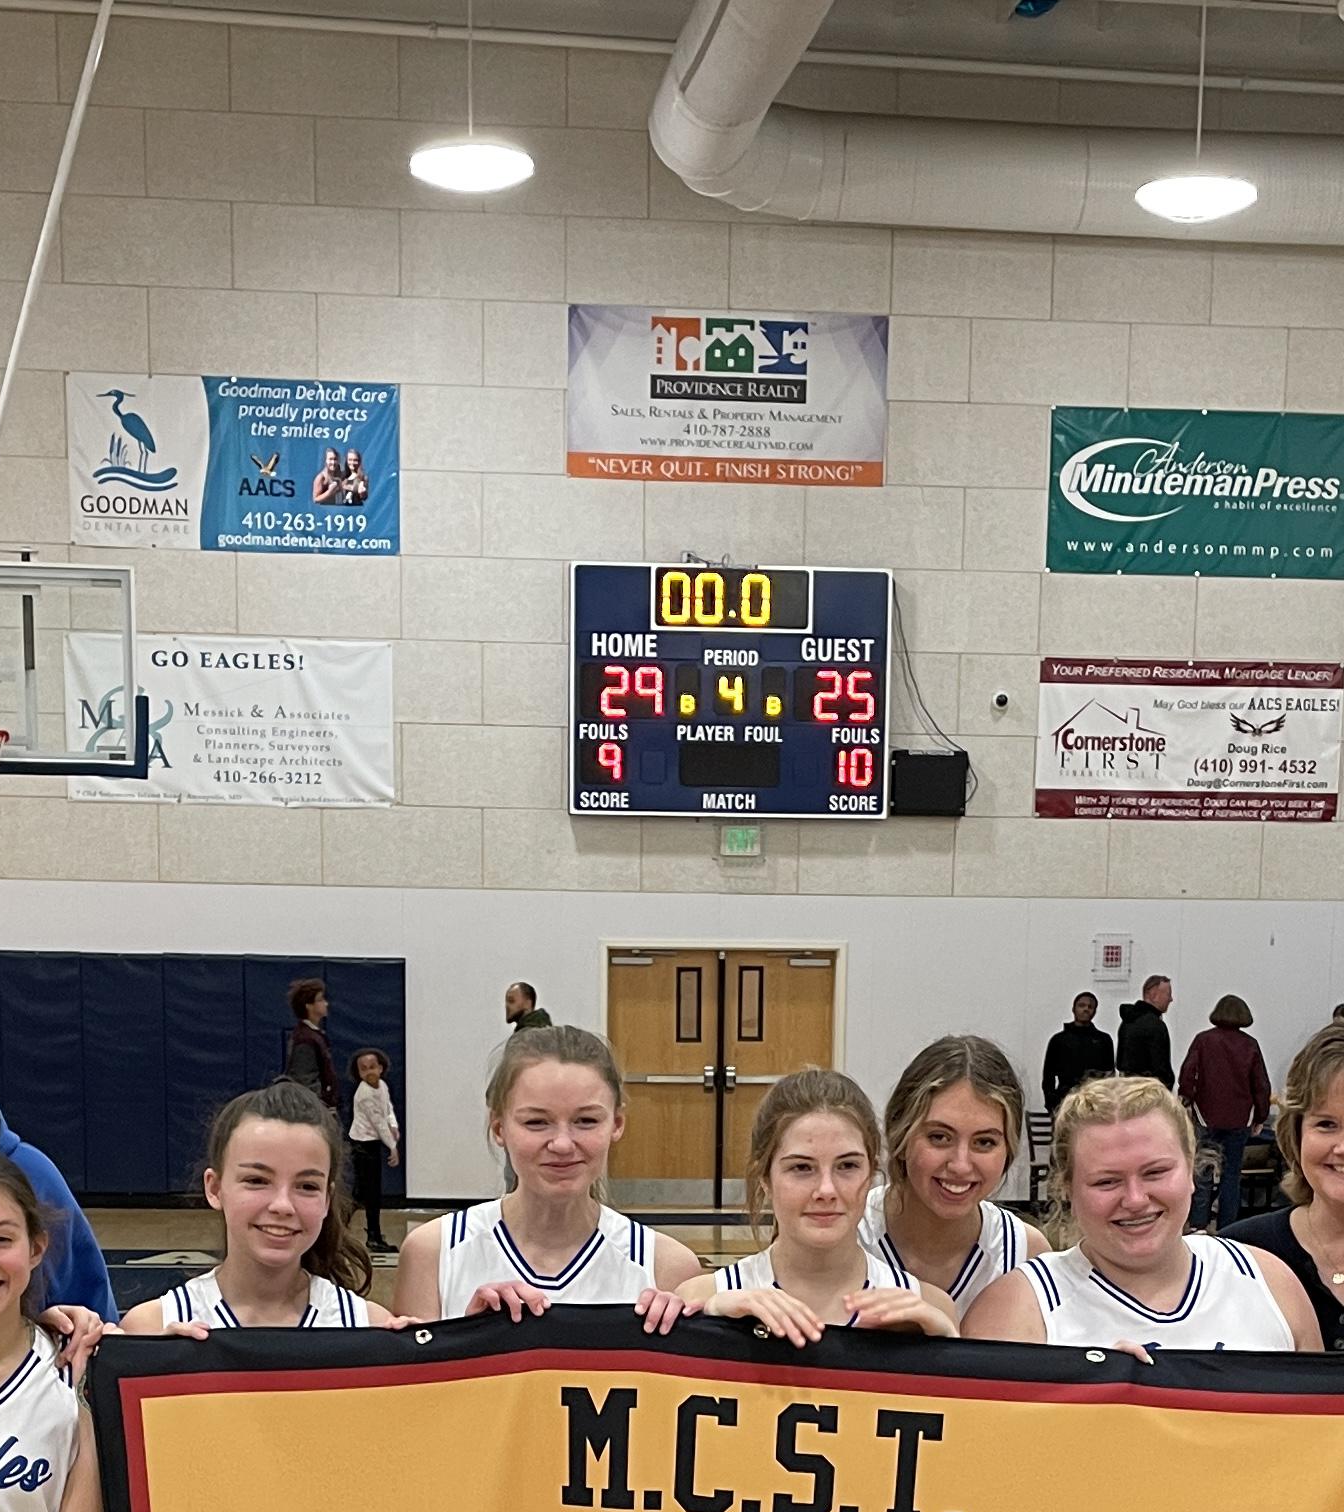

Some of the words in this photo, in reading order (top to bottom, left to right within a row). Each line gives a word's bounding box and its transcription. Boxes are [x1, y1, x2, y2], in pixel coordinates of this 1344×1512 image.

[219, 382, 290, 399] Goodman
[295, 383, 346, 402] Dental
[351, 387, 387, 403] Care
[656, 379, 743, 397] PROVIDENCE
[747, 382, 800, 398] REALTY
[238, 404, 298, 422] proudly
[302, 406, 367, 422] protects
[698, 408, 708, 420] &
[713, 409, 765, 421] PROPERTY
[251, 422, 276, 438] the
[282, 424, 329, 439] smiles
[334, 424, 351, 442] of
[683, 424, 771, 438] 410-787-2888
[660, 460, 708, 478] QUIT.
[716, 461, 769, 478] FINISH
[238, 478, 296, 498] AACS
[1069, 462, 1341, 500] MinutemanPress
[80, 494, 189, 516] GOODMAN
[1224, 500, 1255, 510] habit
[1260, 501, 1271, 511] of
[1276, 503, 1337, 512] excellence
[242, 511, 367, 533] 410-263-1919
[217, 532, 391, 550] goodmandentalcare.com
[1067, 540, 1333, 558] www.andersonmmp.com
[661, 571, 771, 625] 00.0
[591, 633, 657, 657] HOME
[801, 638, 874, 662] GUEST
[151, 650, 189, 668] GO
[200, 652, 304, 671] EAGLES!
[704, 649, 759, 666] PERIOD
[600, 666, 664, 718] 29
[718, 675, 744, 712] 4
[813, 670, 875, 721] 25
[184, 702, 244, 718] Messick
[250, 705, 264, 719] &
[274, 706, 351, 722] Associates
[1248, 698, 1282, 711] AACS
[1286, 698, 1339, 712] EAGLES!
[196, 724, 266, 739] Consulting
[271, 726, 339, 739] Engineers,
[579, 724, 629, 740] FOULS
[676, 725, 734, 742] PLAYER
[744, 726, 783, 743] FOUL
[831, 728, 880, 744] FOULS
[1062, 728, 1166, 752] Cornerstone
[204, 739, 264, 752] Planners,
[268, 742, 331, 754] Surveyors
[207, 754, 274, 767] Landscape
[278, 756, 343, 767] Architects
[598, 742, 623, 780] 9
[837, 748, 873, 787] 10
[1194, 758, 1234, 775] (410)
[1239, 759, 1273, 774] 991-
[1278, 760, 1317, 774] 4532
[213, 770, 323, 786] 410-266-3212
[579, 792, 629, 808] SCORE
[702, 793, 756, 810] MATCH
[829, 795, 877, 811] SCORE
